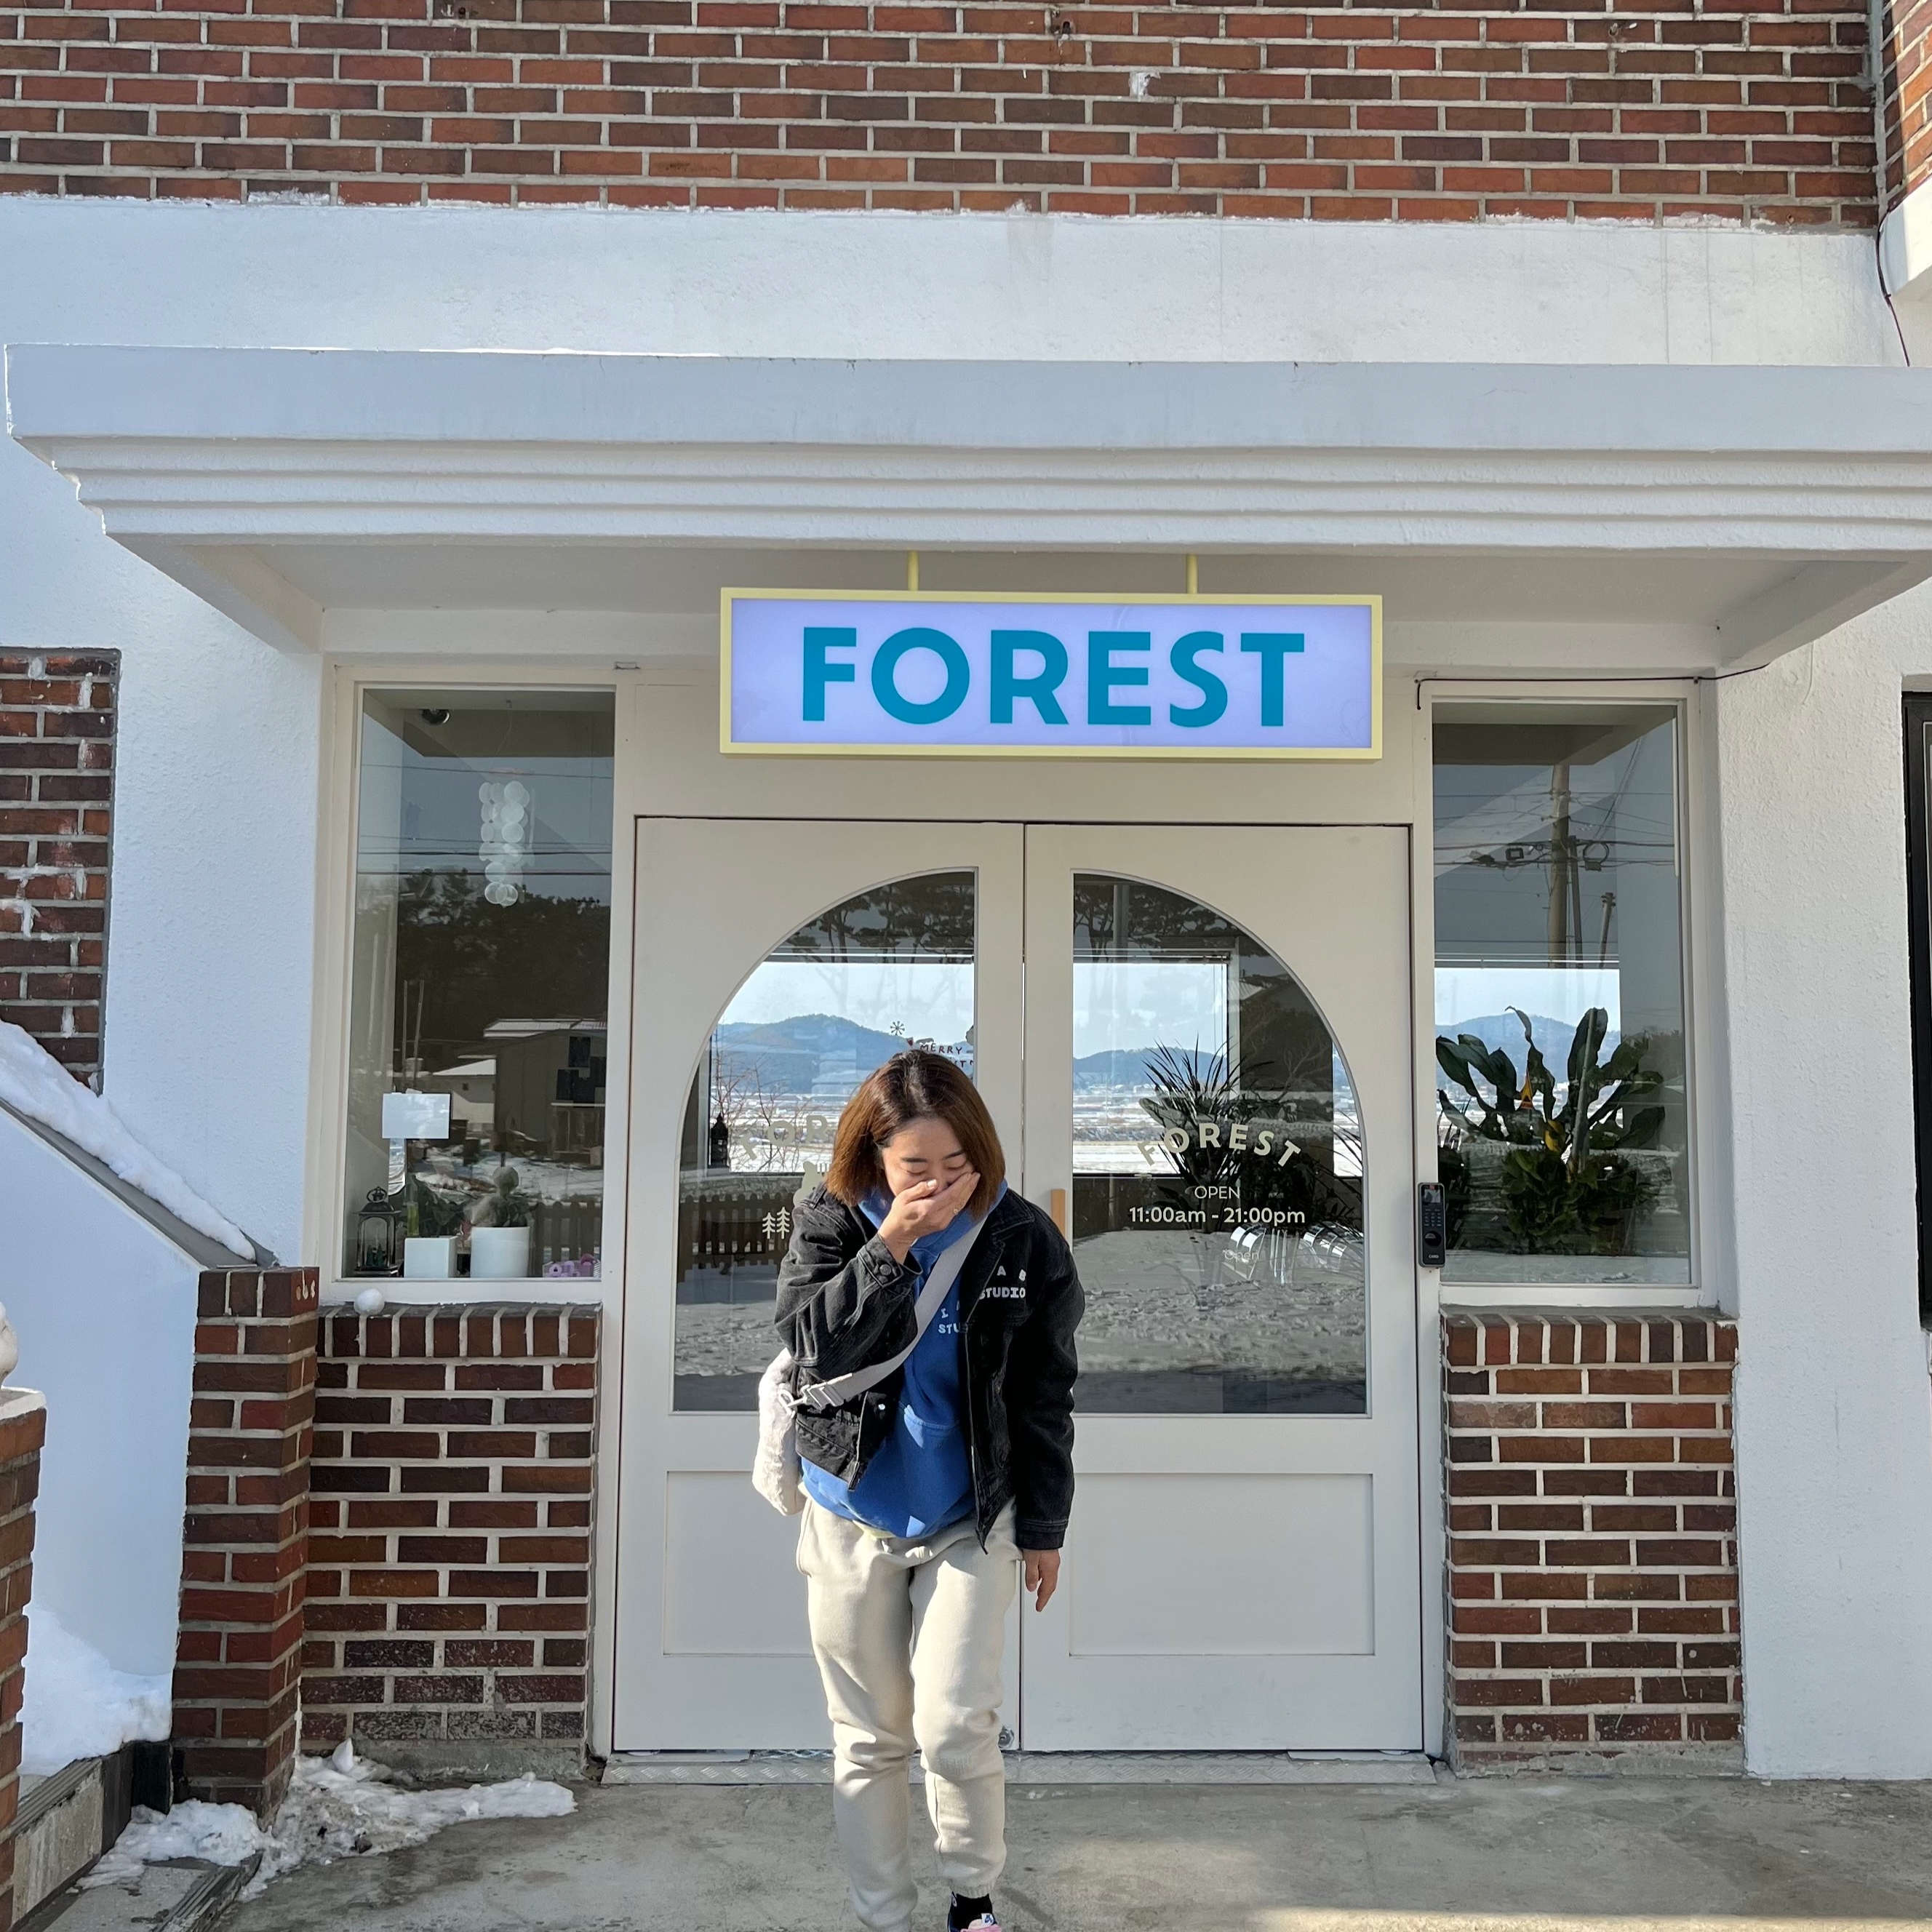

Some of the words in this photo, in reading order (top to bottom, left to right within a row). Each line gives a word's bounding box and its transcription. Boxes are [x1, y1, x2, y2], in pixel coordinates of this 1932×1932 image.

[802, 626, 1305, 727] FOREST
[919, 1042, 962, 1055] MERRY
[740, 1114, 829, 1161] FOR
[1137, 1122, 1301, 1167] FOREST
[1194, 1186, 1240, 1199] OPEN
[1129, 1206, 1206, 1223] 11:00am
[1224, 1207, 1305, 1226] 21:00pm
[979, 1287, 1026, 1300] STUDIO
